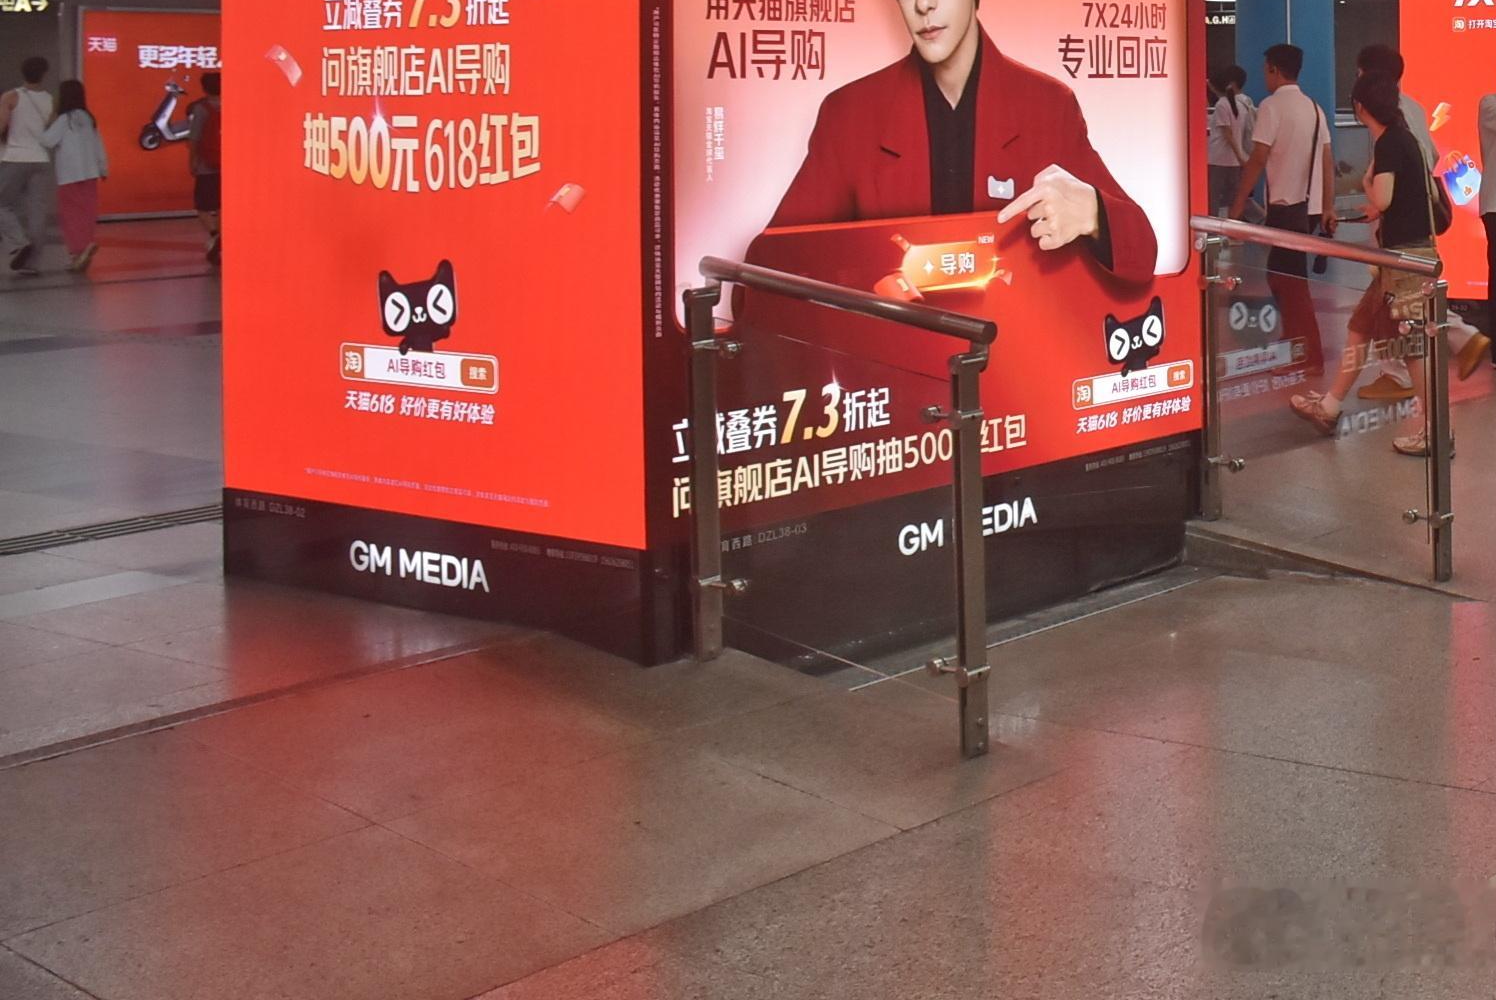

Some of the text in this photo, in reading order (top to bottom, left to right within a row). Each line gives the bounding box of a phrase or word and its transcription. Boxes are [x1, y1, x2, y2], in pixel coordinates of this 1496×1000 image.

[1082, 2, 1167, 31] 7X24小时
[138, 45, 223, 69] 更多年轻
[321, 42, 511, 97] 问旗舰店AI导购
[706, 27, 826, 81] AI导购
[1058, 34, 1168, 79] 专业回应
[303, 111, 541, 193] 抽500元618红包
[940, 252, 975, 275] 导购
[1075, 396, 1192, 434] 天猫618 好价更有好体验
[898, 496, 1038, 556] GM EDIA
[350, 539, 392, 576] GM
[399, 547, 490, 593] MEDIA
